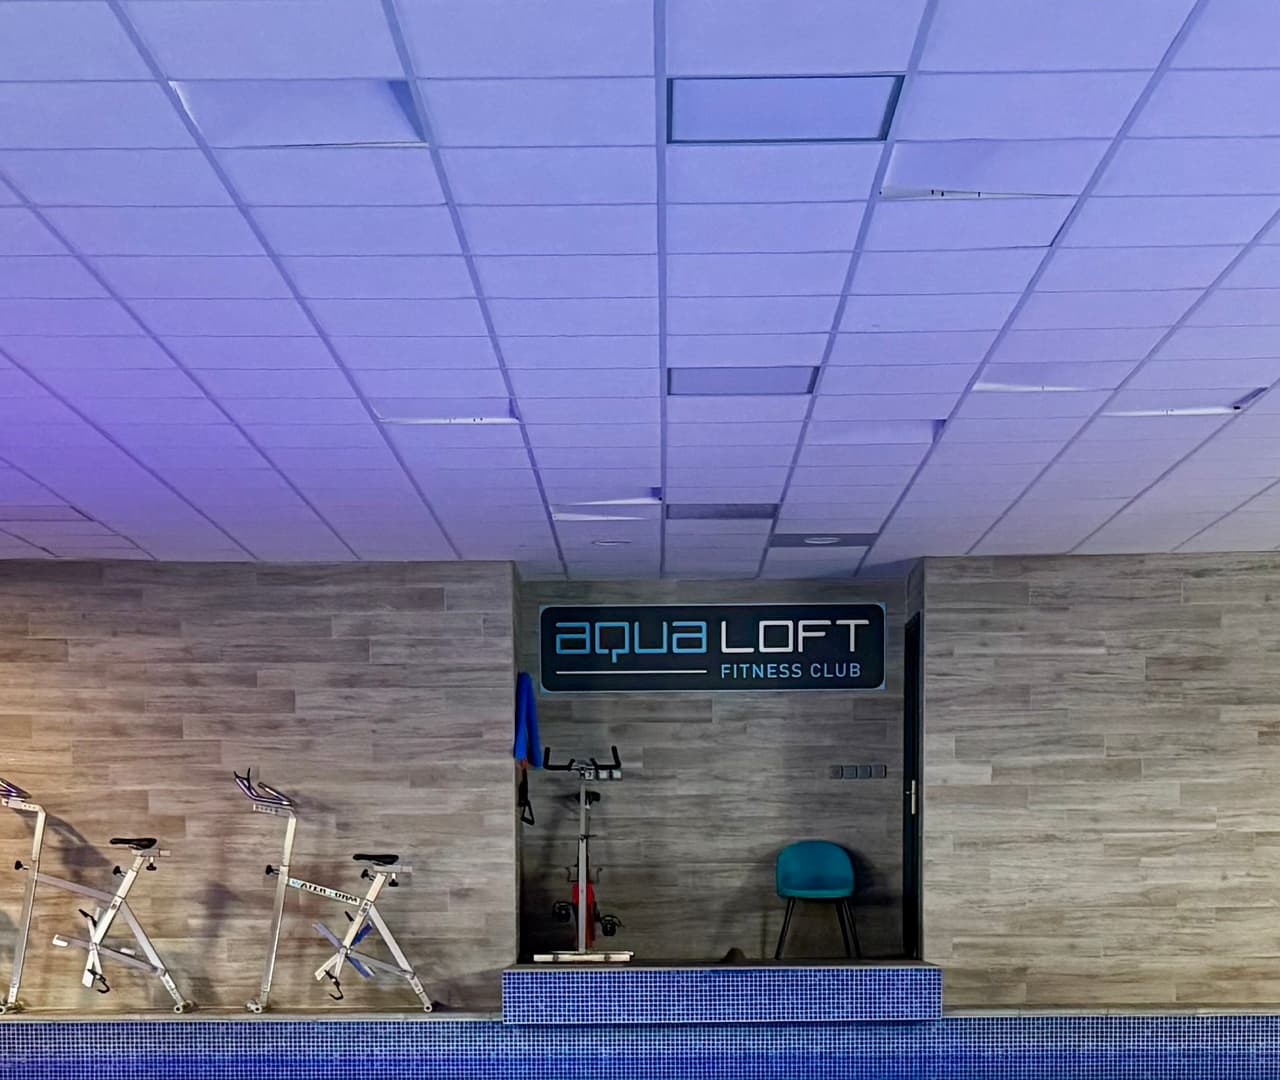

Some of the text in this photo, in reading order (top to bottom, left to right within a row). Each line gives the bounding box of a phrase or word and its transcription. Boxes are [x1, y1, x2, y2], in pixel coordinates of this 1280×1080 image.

[721, 620, 869, 653] LOFT
[721, 664, 861, 679] FITNESS CLUB
